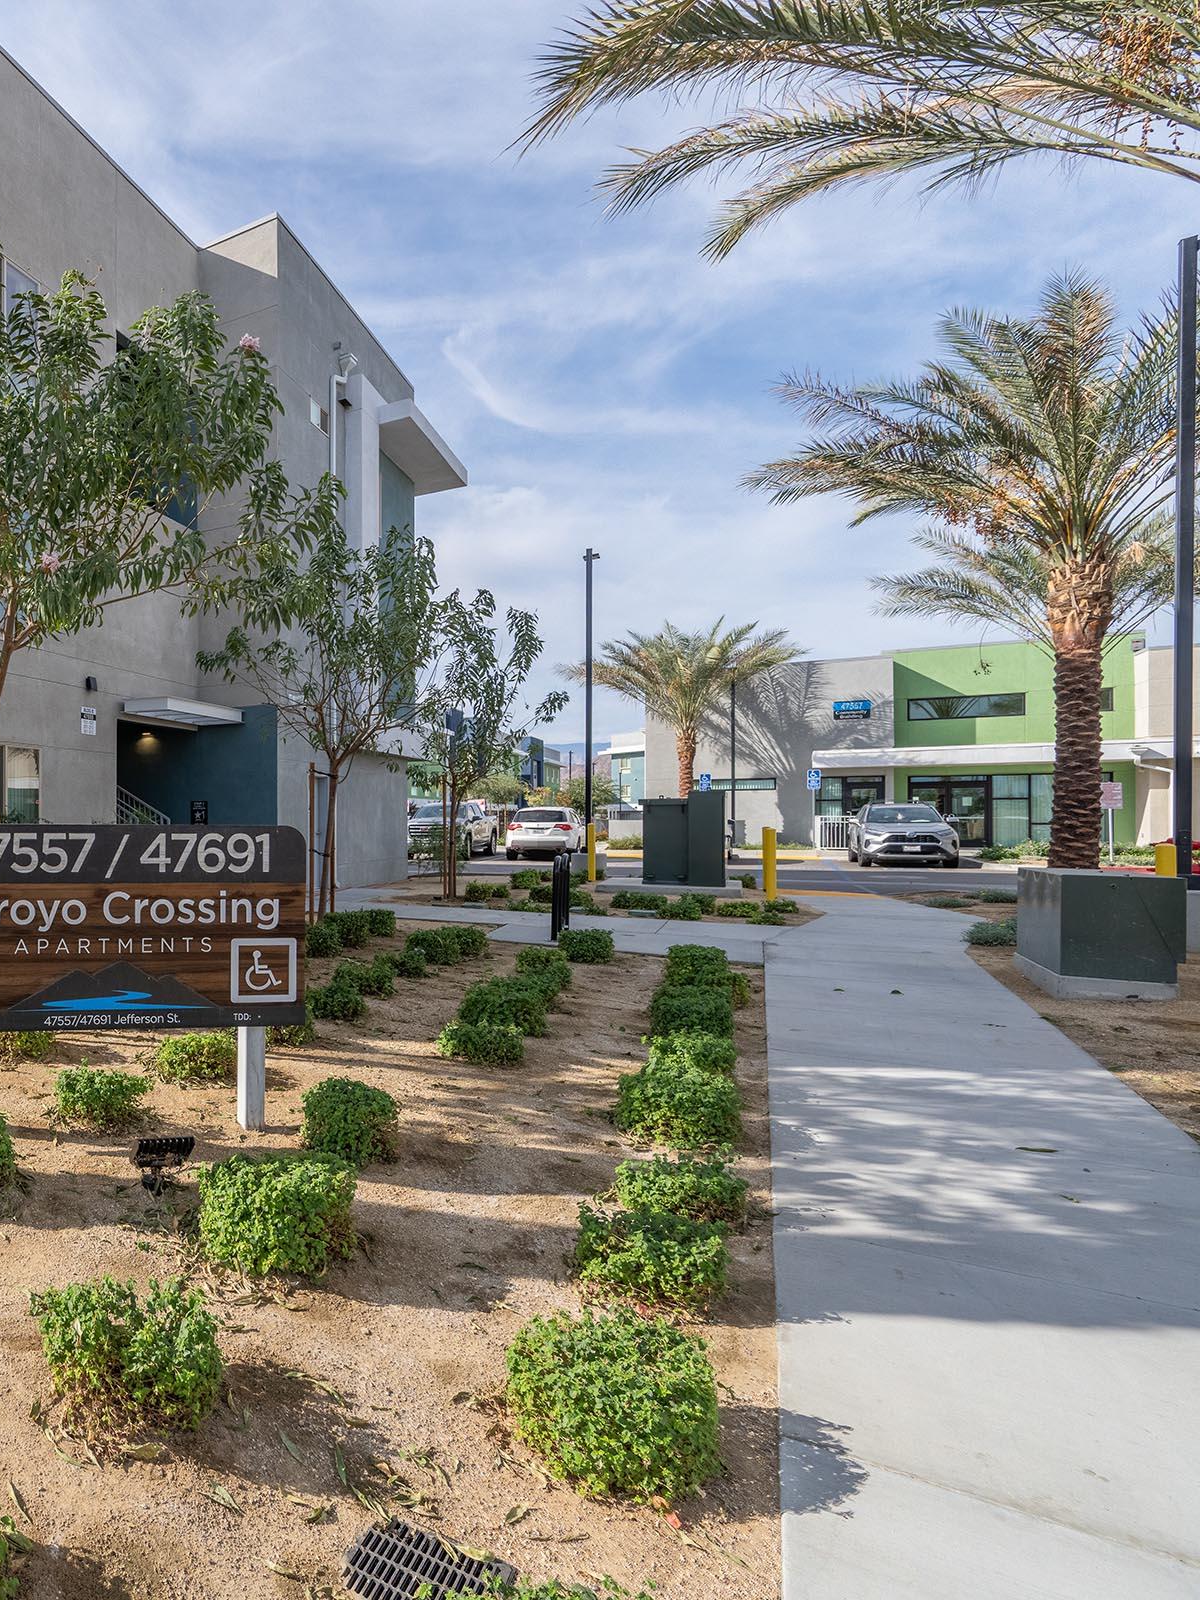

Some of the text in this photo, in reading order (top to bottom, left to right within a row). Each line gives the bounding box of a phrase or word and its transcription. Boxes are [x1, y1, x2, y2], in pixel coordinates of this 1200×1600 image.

[105, 833, 131, 879] /
[140, 833, 270, 873] 47691
[103, 890, 280, 930] Crossing
[14, 936, 213, 955] APARTMENTS
[43, 1013, 181, 1027] 47557/47691 Jefferson St.
[233, 1013, 253, 1021] TDD:
